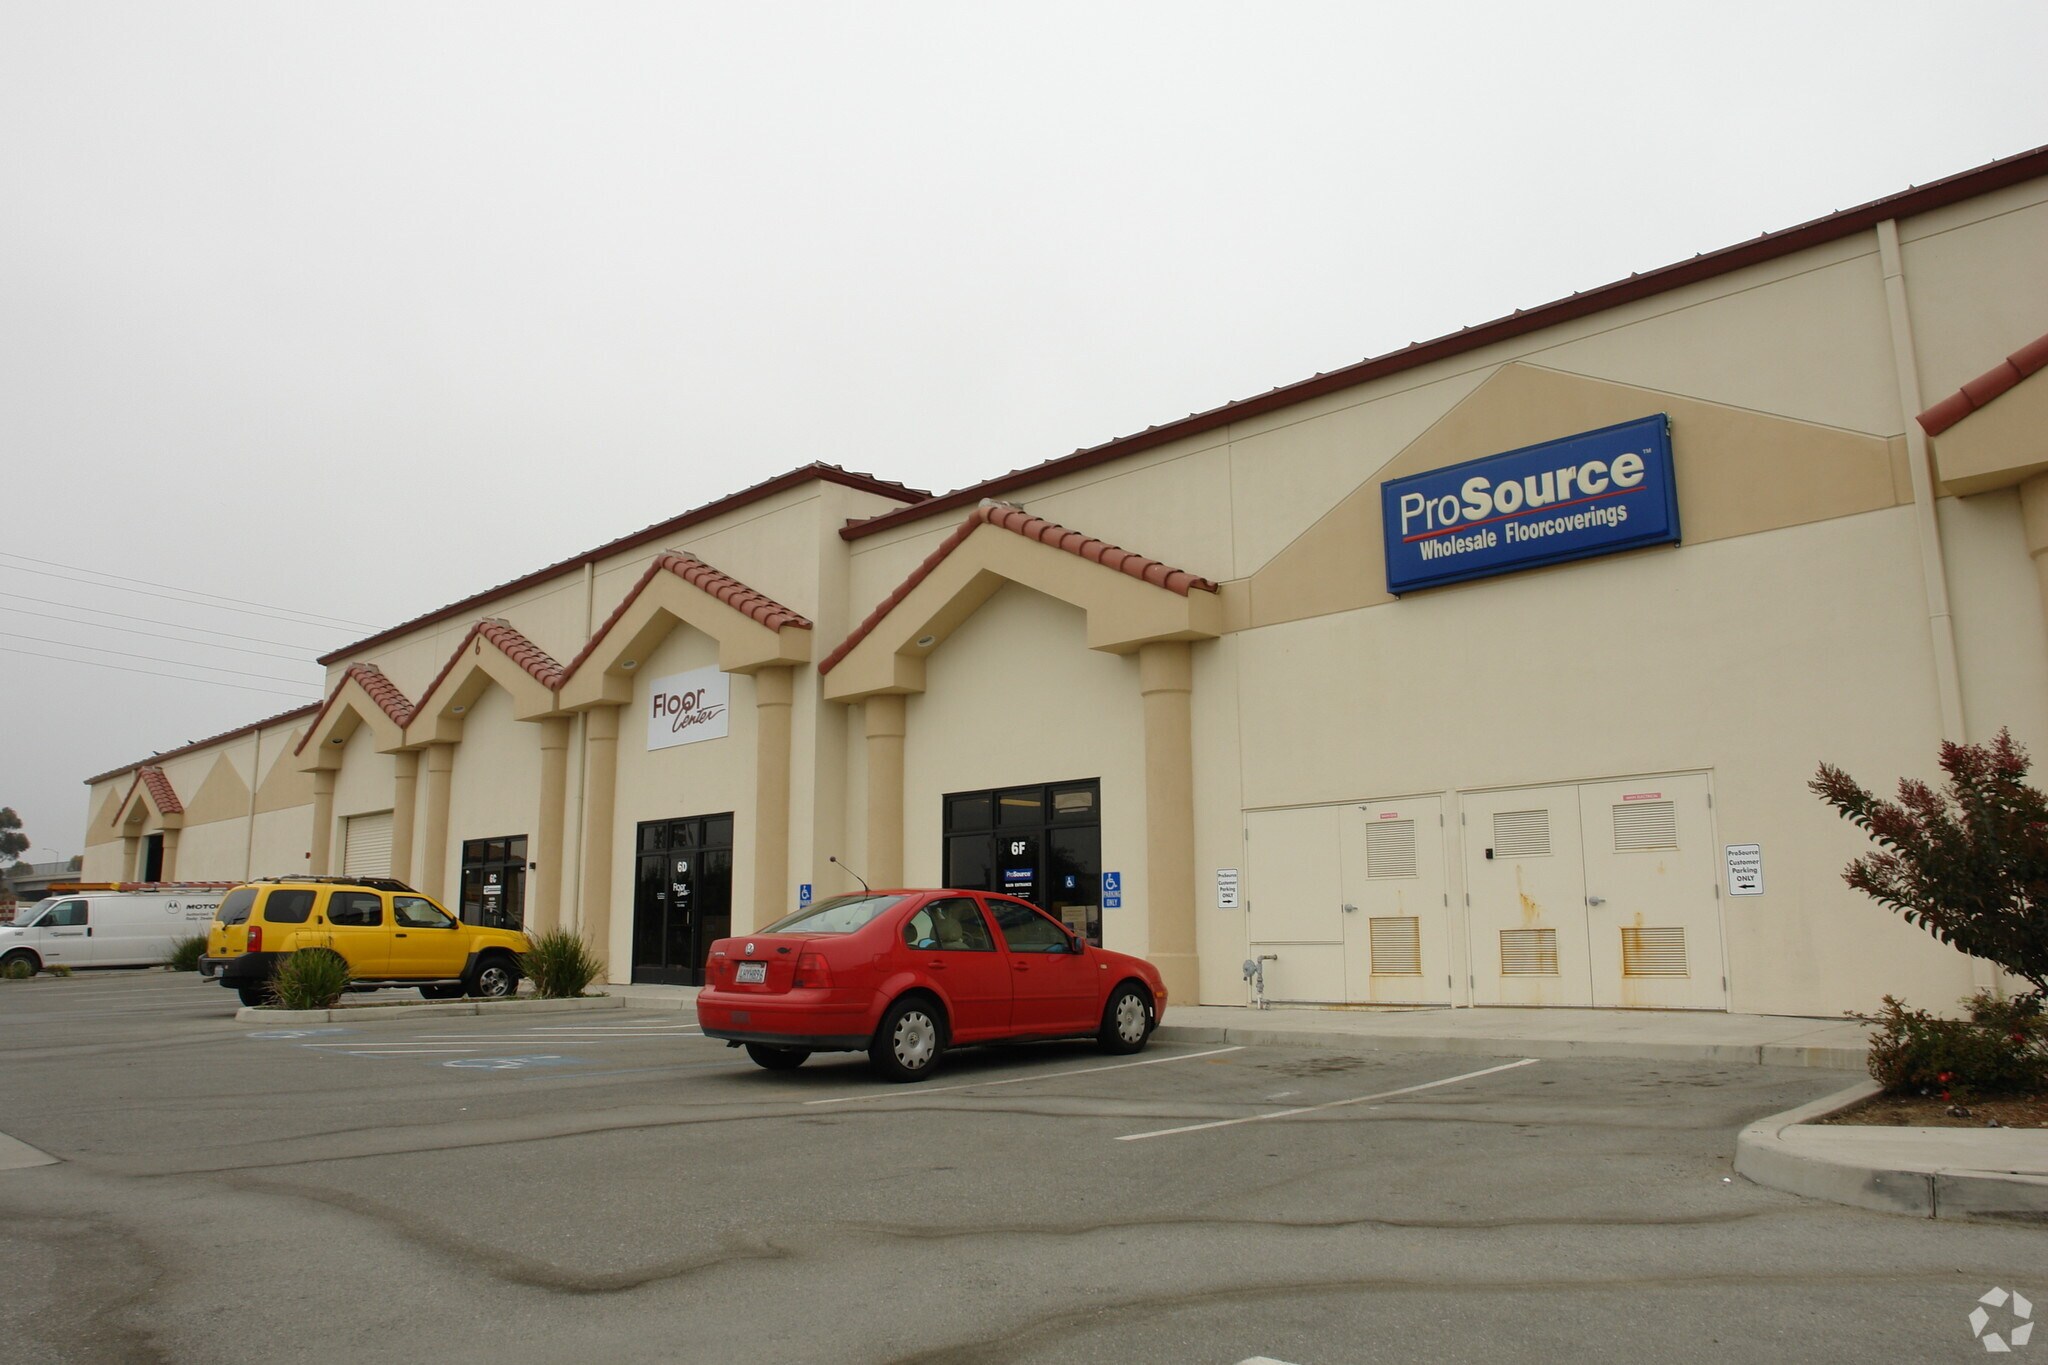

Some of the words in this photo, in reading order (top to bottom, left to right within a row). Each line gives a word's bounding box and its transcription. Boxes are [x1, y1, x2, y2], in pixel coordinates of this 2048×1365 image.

[1400, 452, 1645, 535] ProSource
[1419, 529, 1497, 561] Wholesale
[1504, 504, 1628, 544] Floorcoverings
[653, 688, 706, 719] Floor
[671, 701, 726, 733] Center
[1011, 841, 1026, 856] 6F
[677, 861, 688, 873] 6D
[1107, 898, 1118, 907] ONLY
